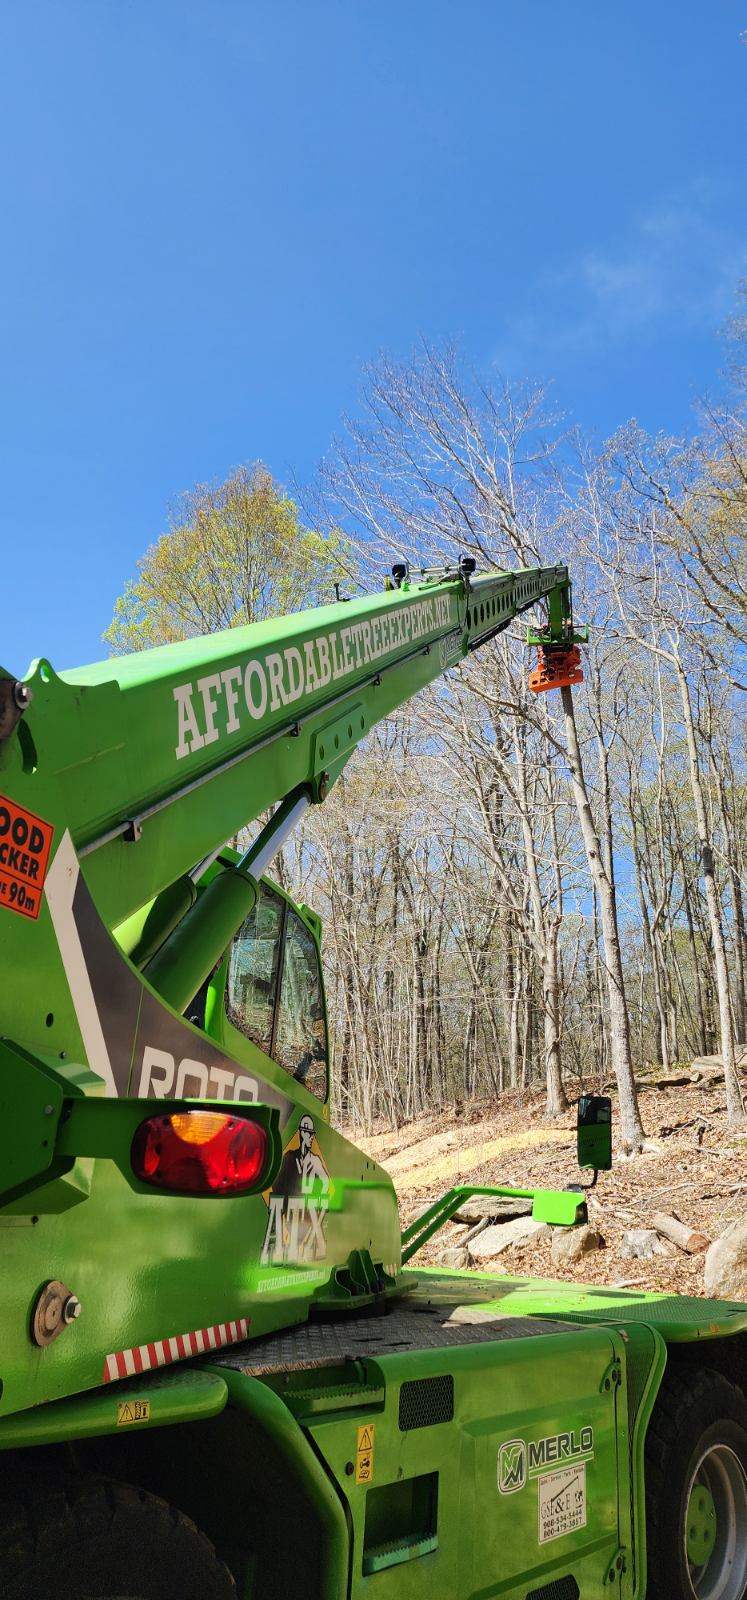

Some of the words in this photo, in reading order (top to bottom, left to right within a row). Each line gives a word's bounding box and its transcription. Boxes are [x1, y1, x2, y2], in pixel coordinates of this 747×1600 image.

[172, 592, 452, 760] AFFORDABLETREEEXPERTS.NET
[9, 881, 35, 912] 90m
[138, 1046, 259, 1103] ROTO
[260, 1194, 328, 1267] ATX
[529, 1426, 593, 1468] MERLO
